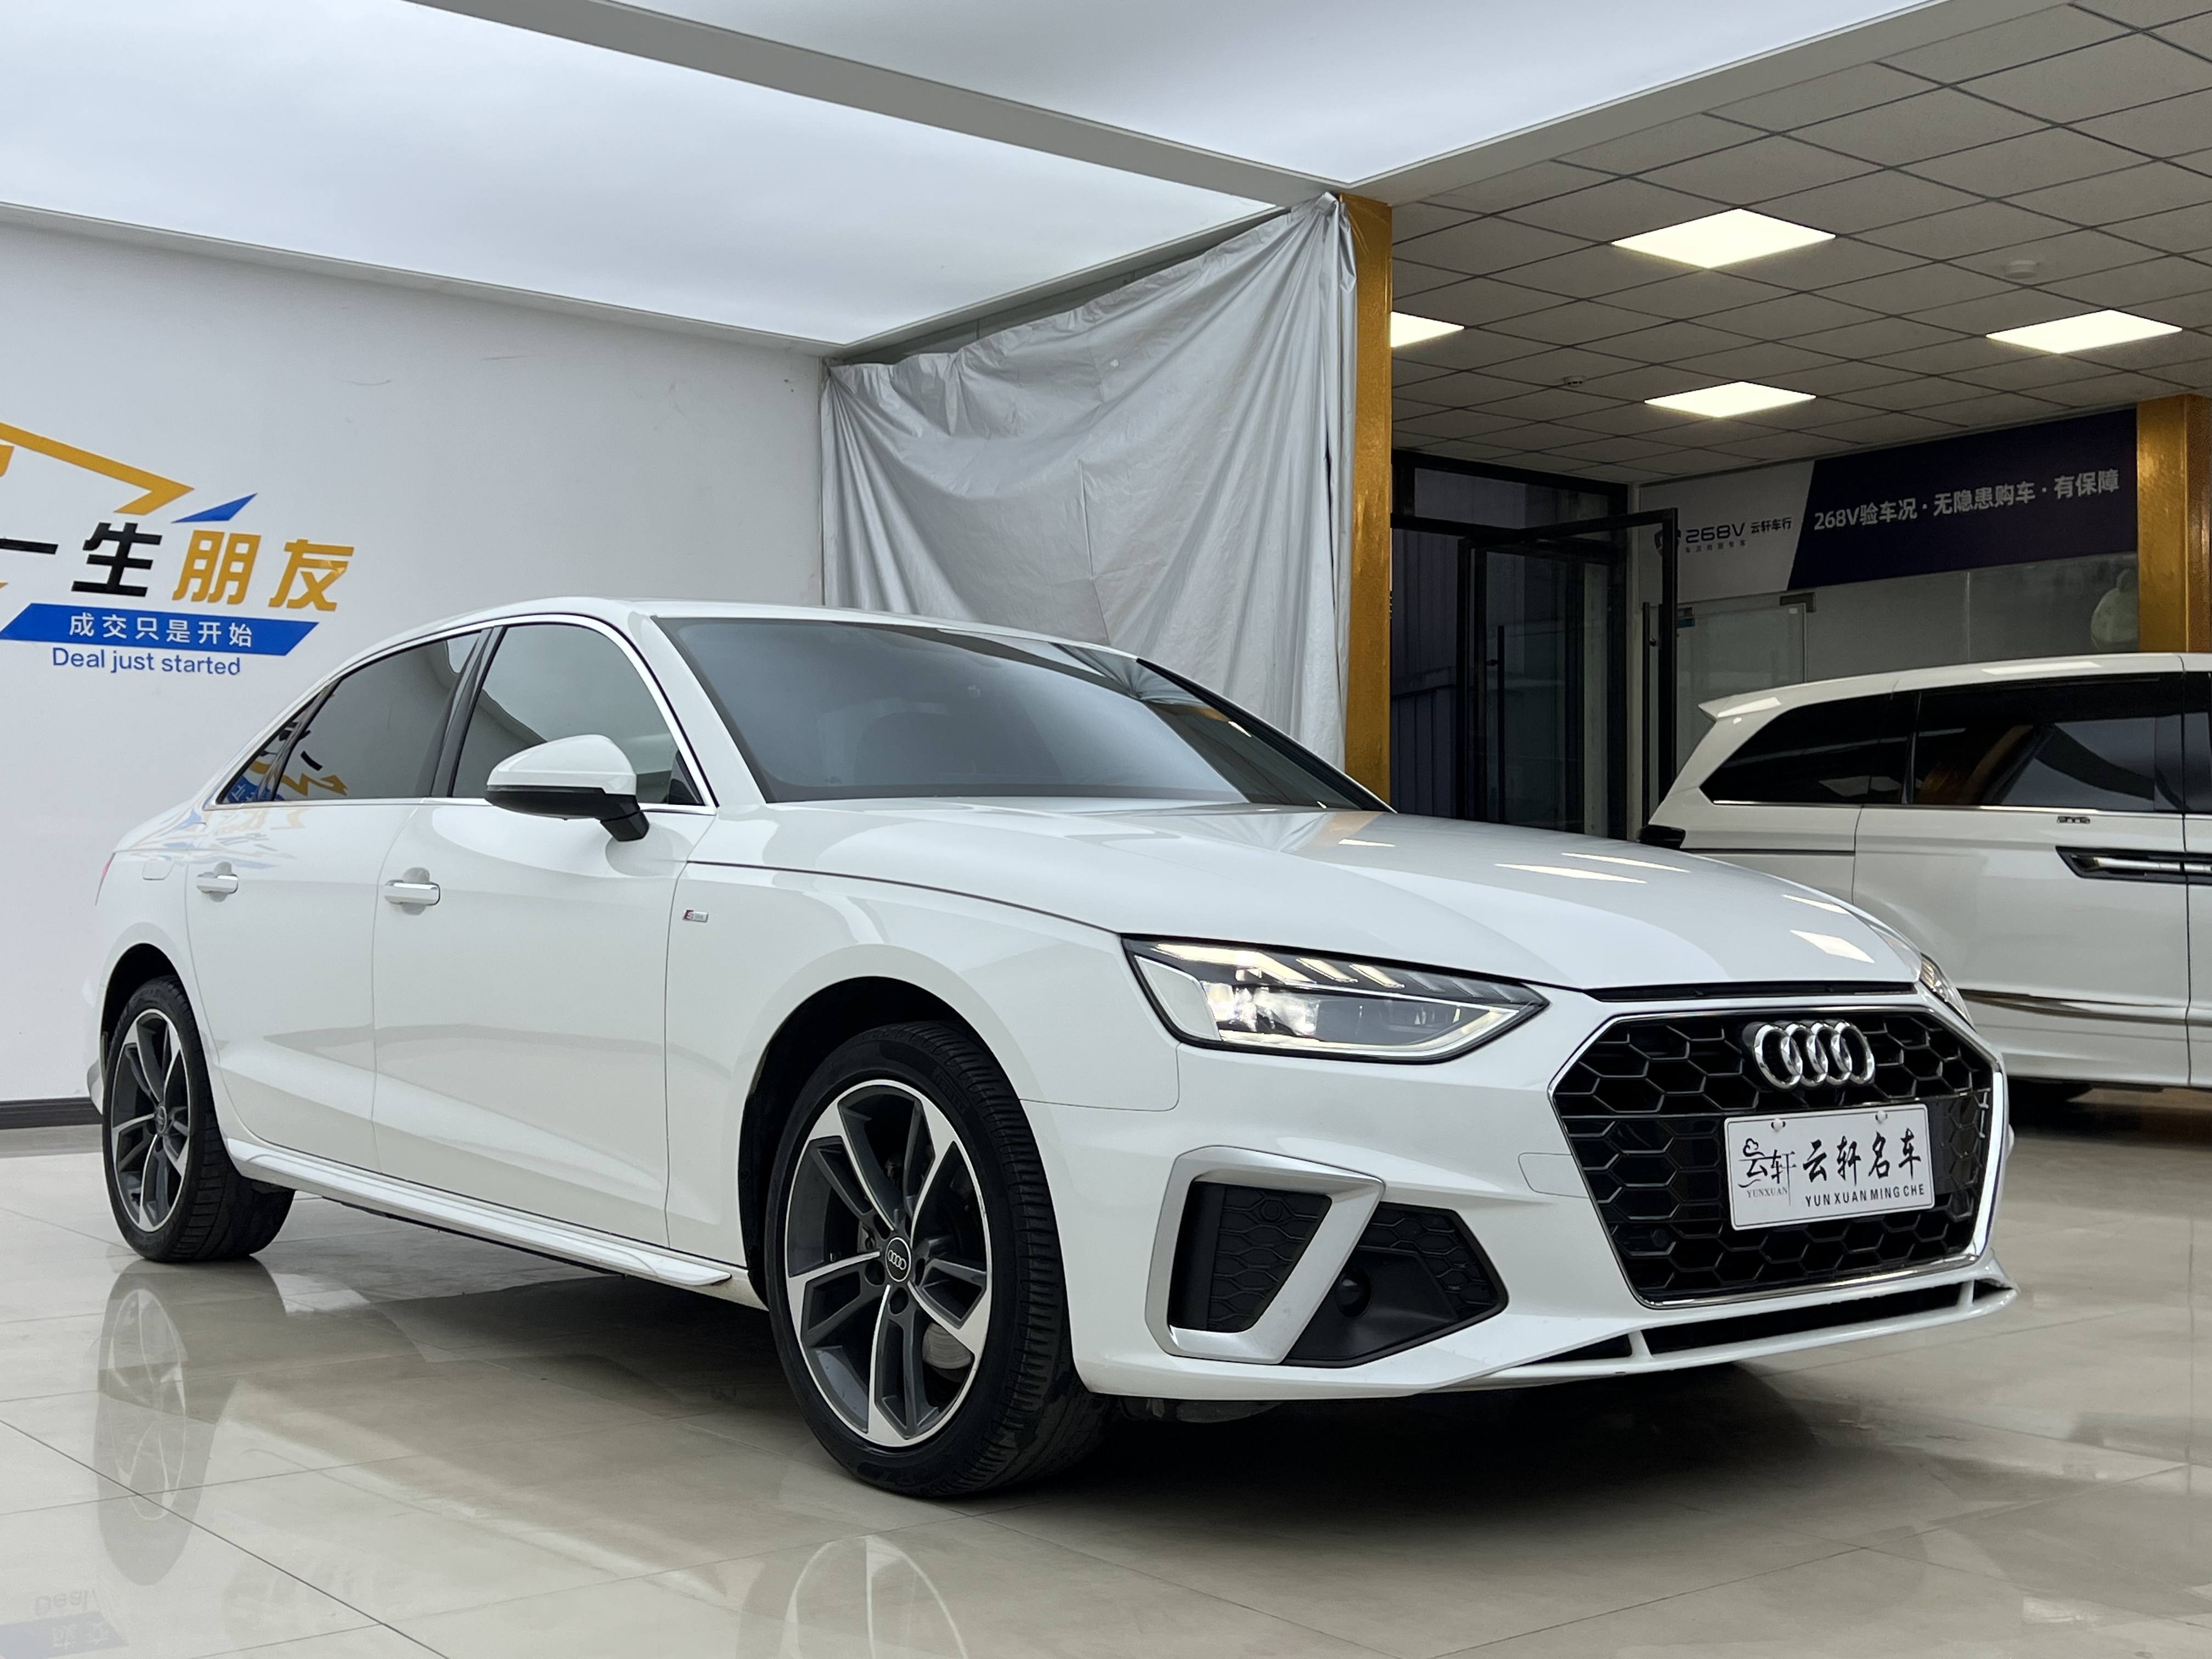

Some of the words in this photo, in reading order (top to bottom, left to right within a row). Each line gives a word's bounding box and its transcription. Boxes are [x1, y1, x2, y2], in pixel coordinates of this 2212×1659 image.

[1685, 522, 1746, 544] 268V
[1751, 517, 1792, 534] 云轩车行
[69, 612, 252, 648] 成交只是开始
[53, 647, 104, 667] Deal
[111, 650, 154, 673] just
[162, 654, 240, 675] started
[1802, 1127, 1922, 1187] 云轩名车
[1746, 1186, 1788, 1198] YUNXUAN
